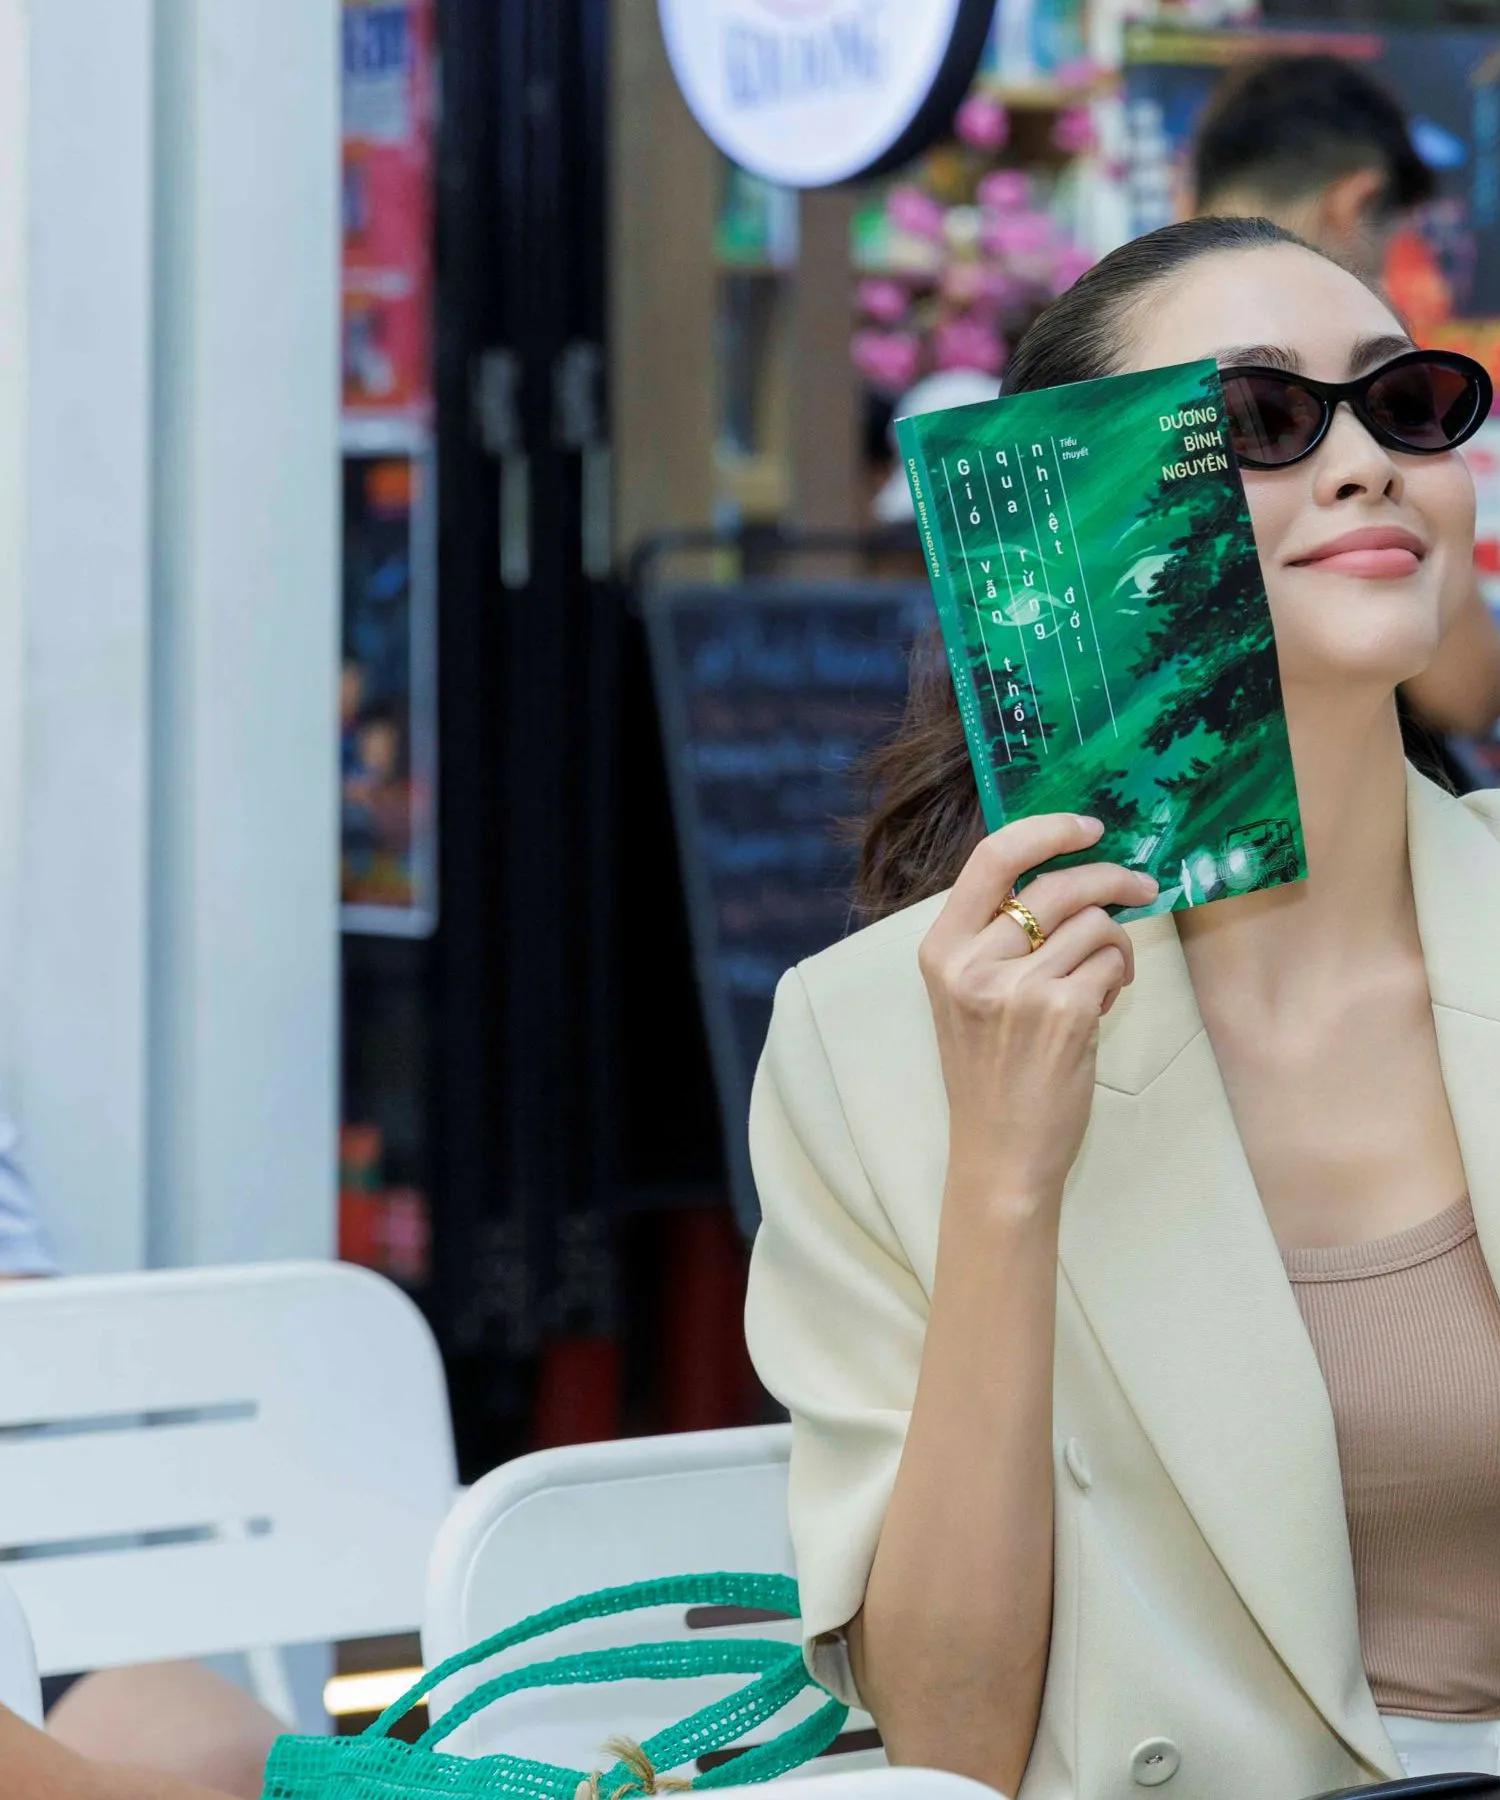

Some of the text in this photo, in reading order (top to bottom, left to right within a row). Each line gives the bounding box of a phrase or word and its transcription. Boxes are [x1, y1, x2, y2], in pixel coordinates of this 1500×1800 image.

[1159, 406, 1217, 432] DƯƠNG
[1183, 430, 1223, 452] BÌNH
[1161, 453, 1229, 481] NGUYÊN
[957, 458, 981, 525] Gió
